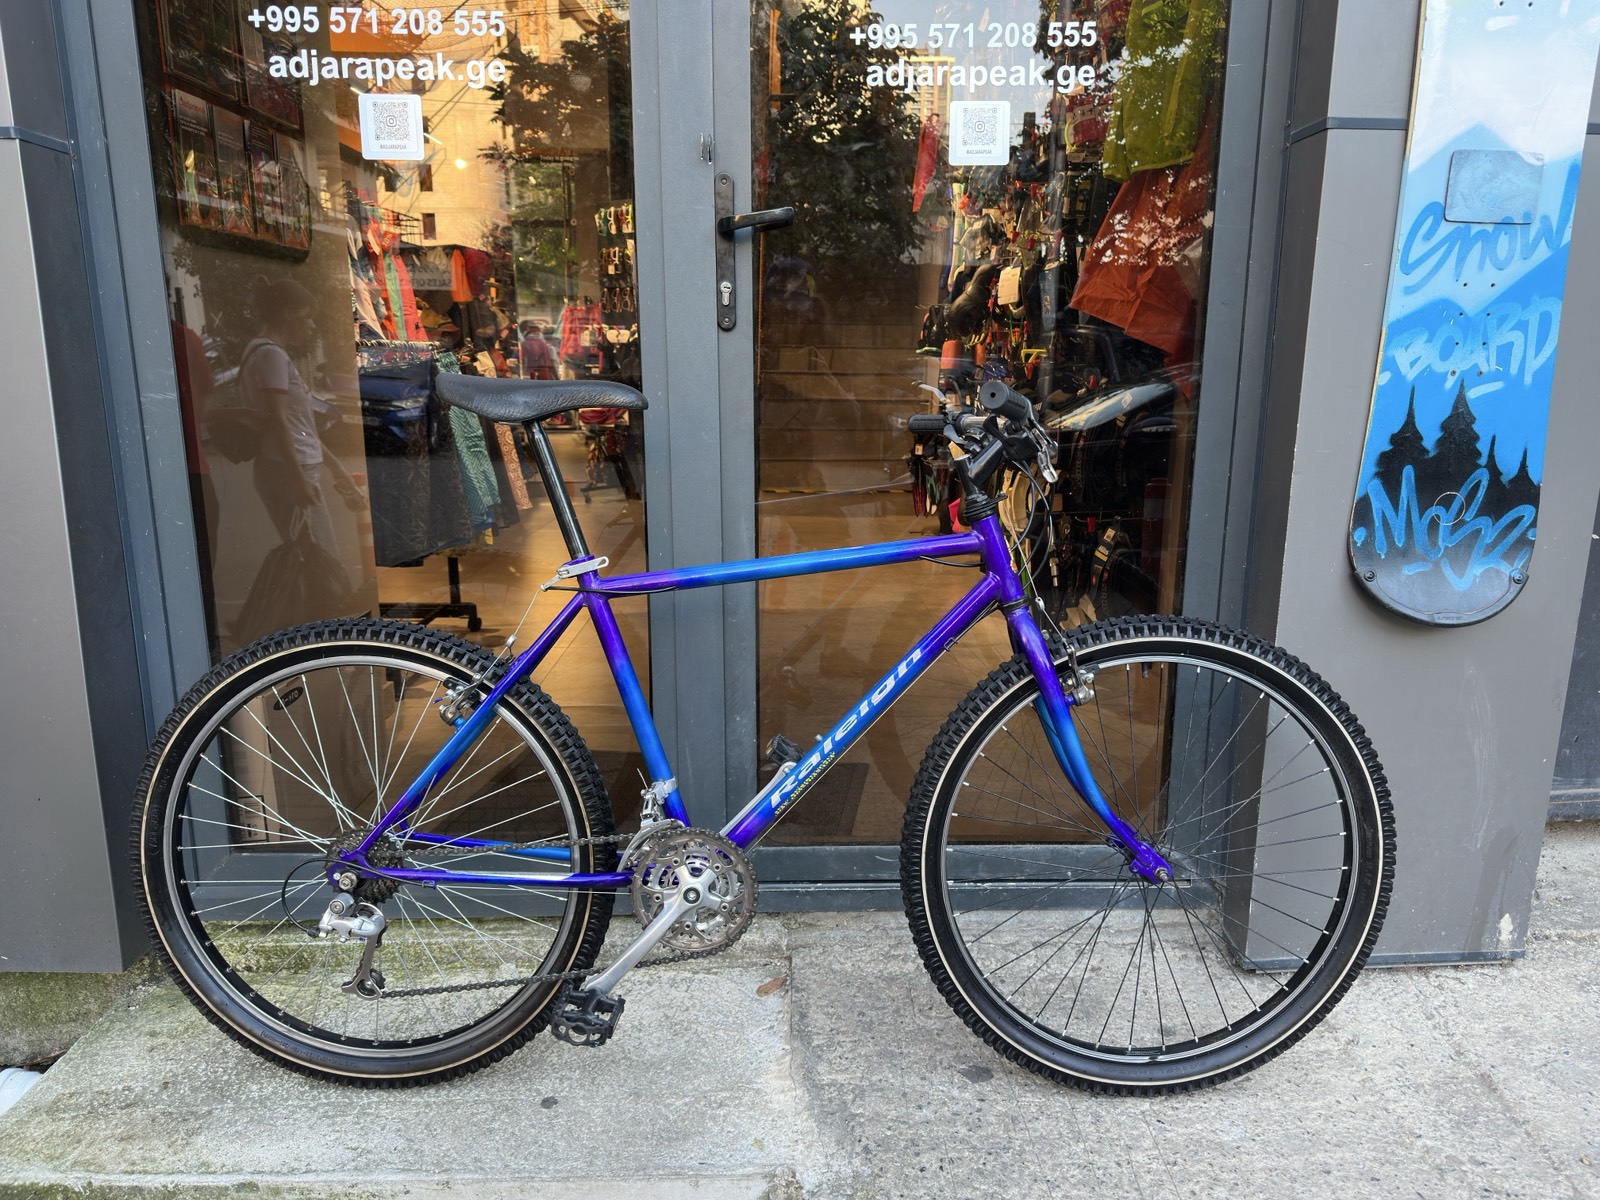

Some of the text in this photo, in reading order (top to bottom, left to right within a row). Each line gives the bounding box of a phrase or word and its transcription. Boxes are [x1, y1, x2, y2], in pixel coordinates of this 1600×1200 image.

[248, 5, 506, 37] +995 571 208 555
[849, 20, 1097, 49] +995 571 208 555
[268, 49, 506, 88] adjarapeak.ge
[866, 59, 1096, 94] adjarapeak.ge
[1387, 296, 1563, 390] BOARD
[770, 649, 922, 808] Raleigh
